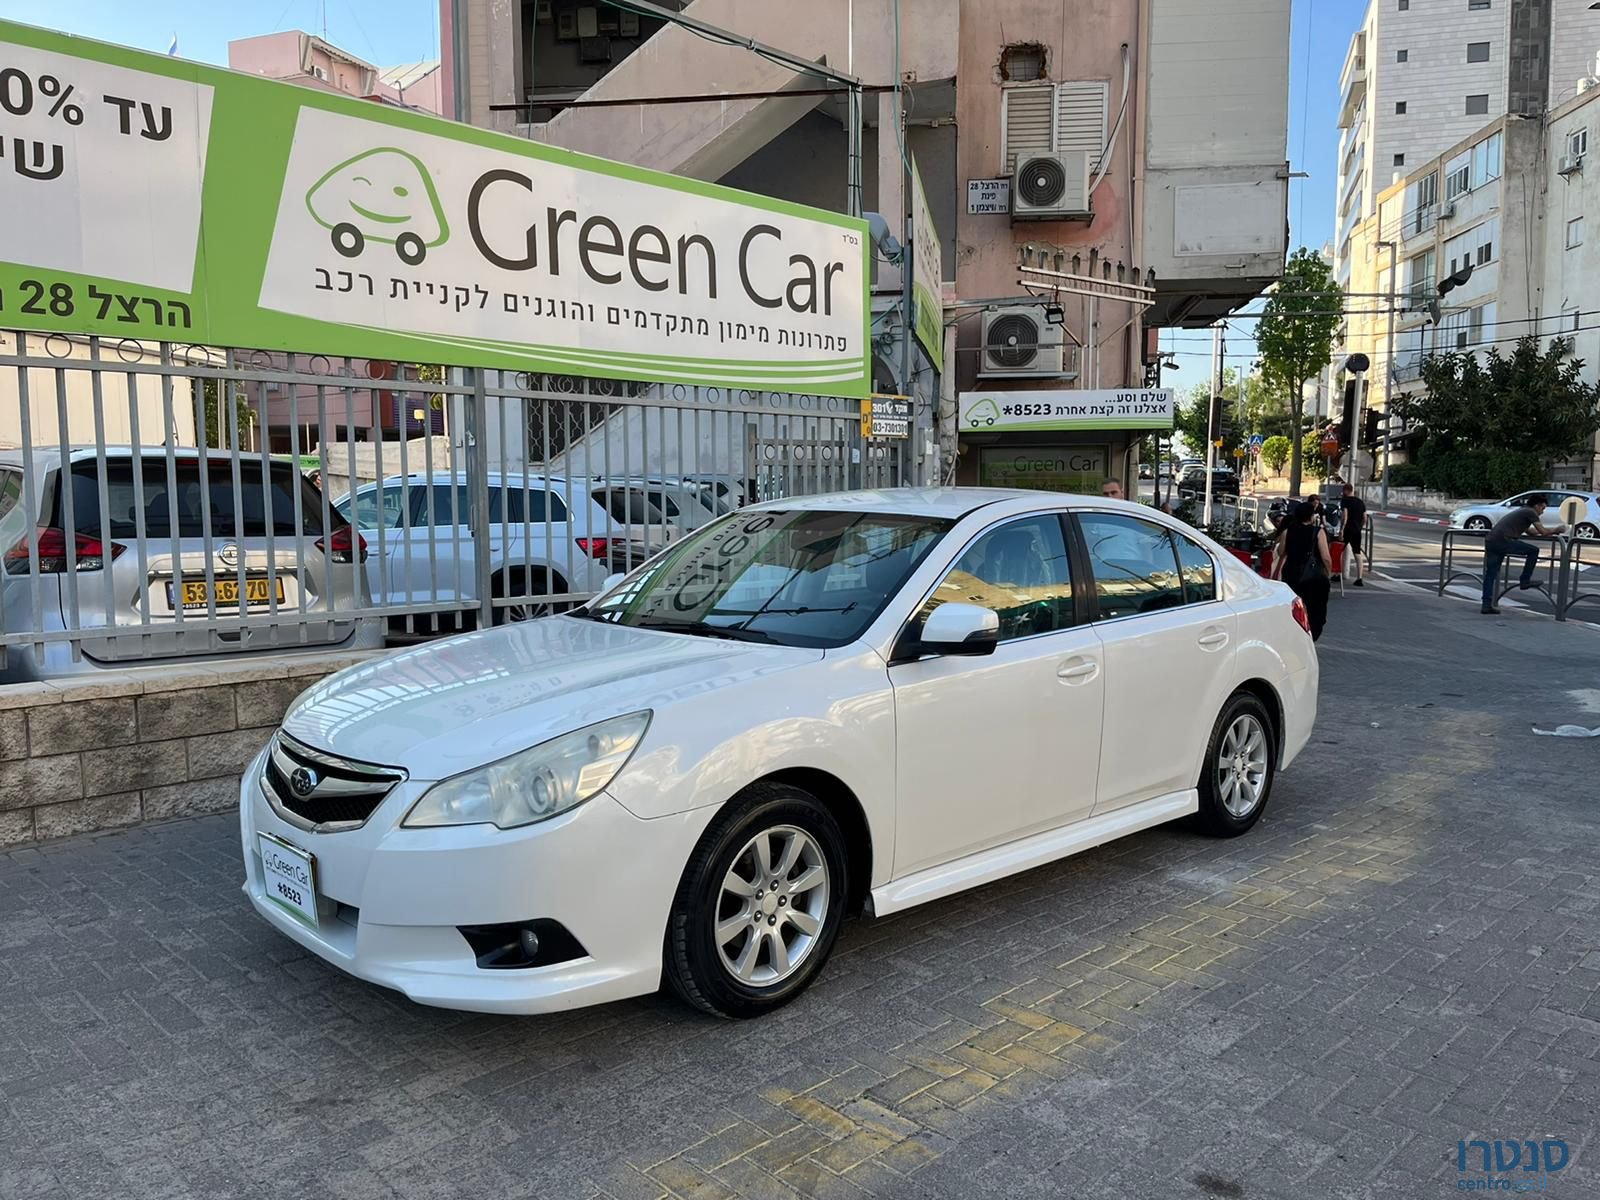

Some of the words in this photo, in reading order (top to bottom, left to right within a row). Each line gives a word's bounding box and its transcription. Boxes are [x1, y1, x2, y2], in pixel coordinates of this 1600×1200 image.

[103, 95, 172, 141] עד
[981, 192, 996, 200] פינת
[467, 168, 718, 300] Green
[738, 223, 844, 316] Car
[315, 268, 374, 295] רכב
[19, 280, 74, 317] 28
[88, 285, 192, 328] הרצל
[389, 277, 489, 312] לקניית
[503, 293, 594, 322] והוגנים
[607, 306, 709, 337] מתקדמים
[719, 321, 769, 343] מימון
[777, 328, 847, 352] פתרונות
[872, 403, 886, 413] 301
[1134, 403, 1167, 413] אצלנו
[1141, 391, 1167, 402] שלם
[1055, 406, 1087, 415] אחרת
[1090, 405, 1114, 416] קצת
[1118, 405, 1131, 414] זה
[1013, 455, 1065, 472] Green
[1069, 455, 1099, 471] Car
[272, 853, 296, 878] Green
[295, 866, 309, 884] Car
